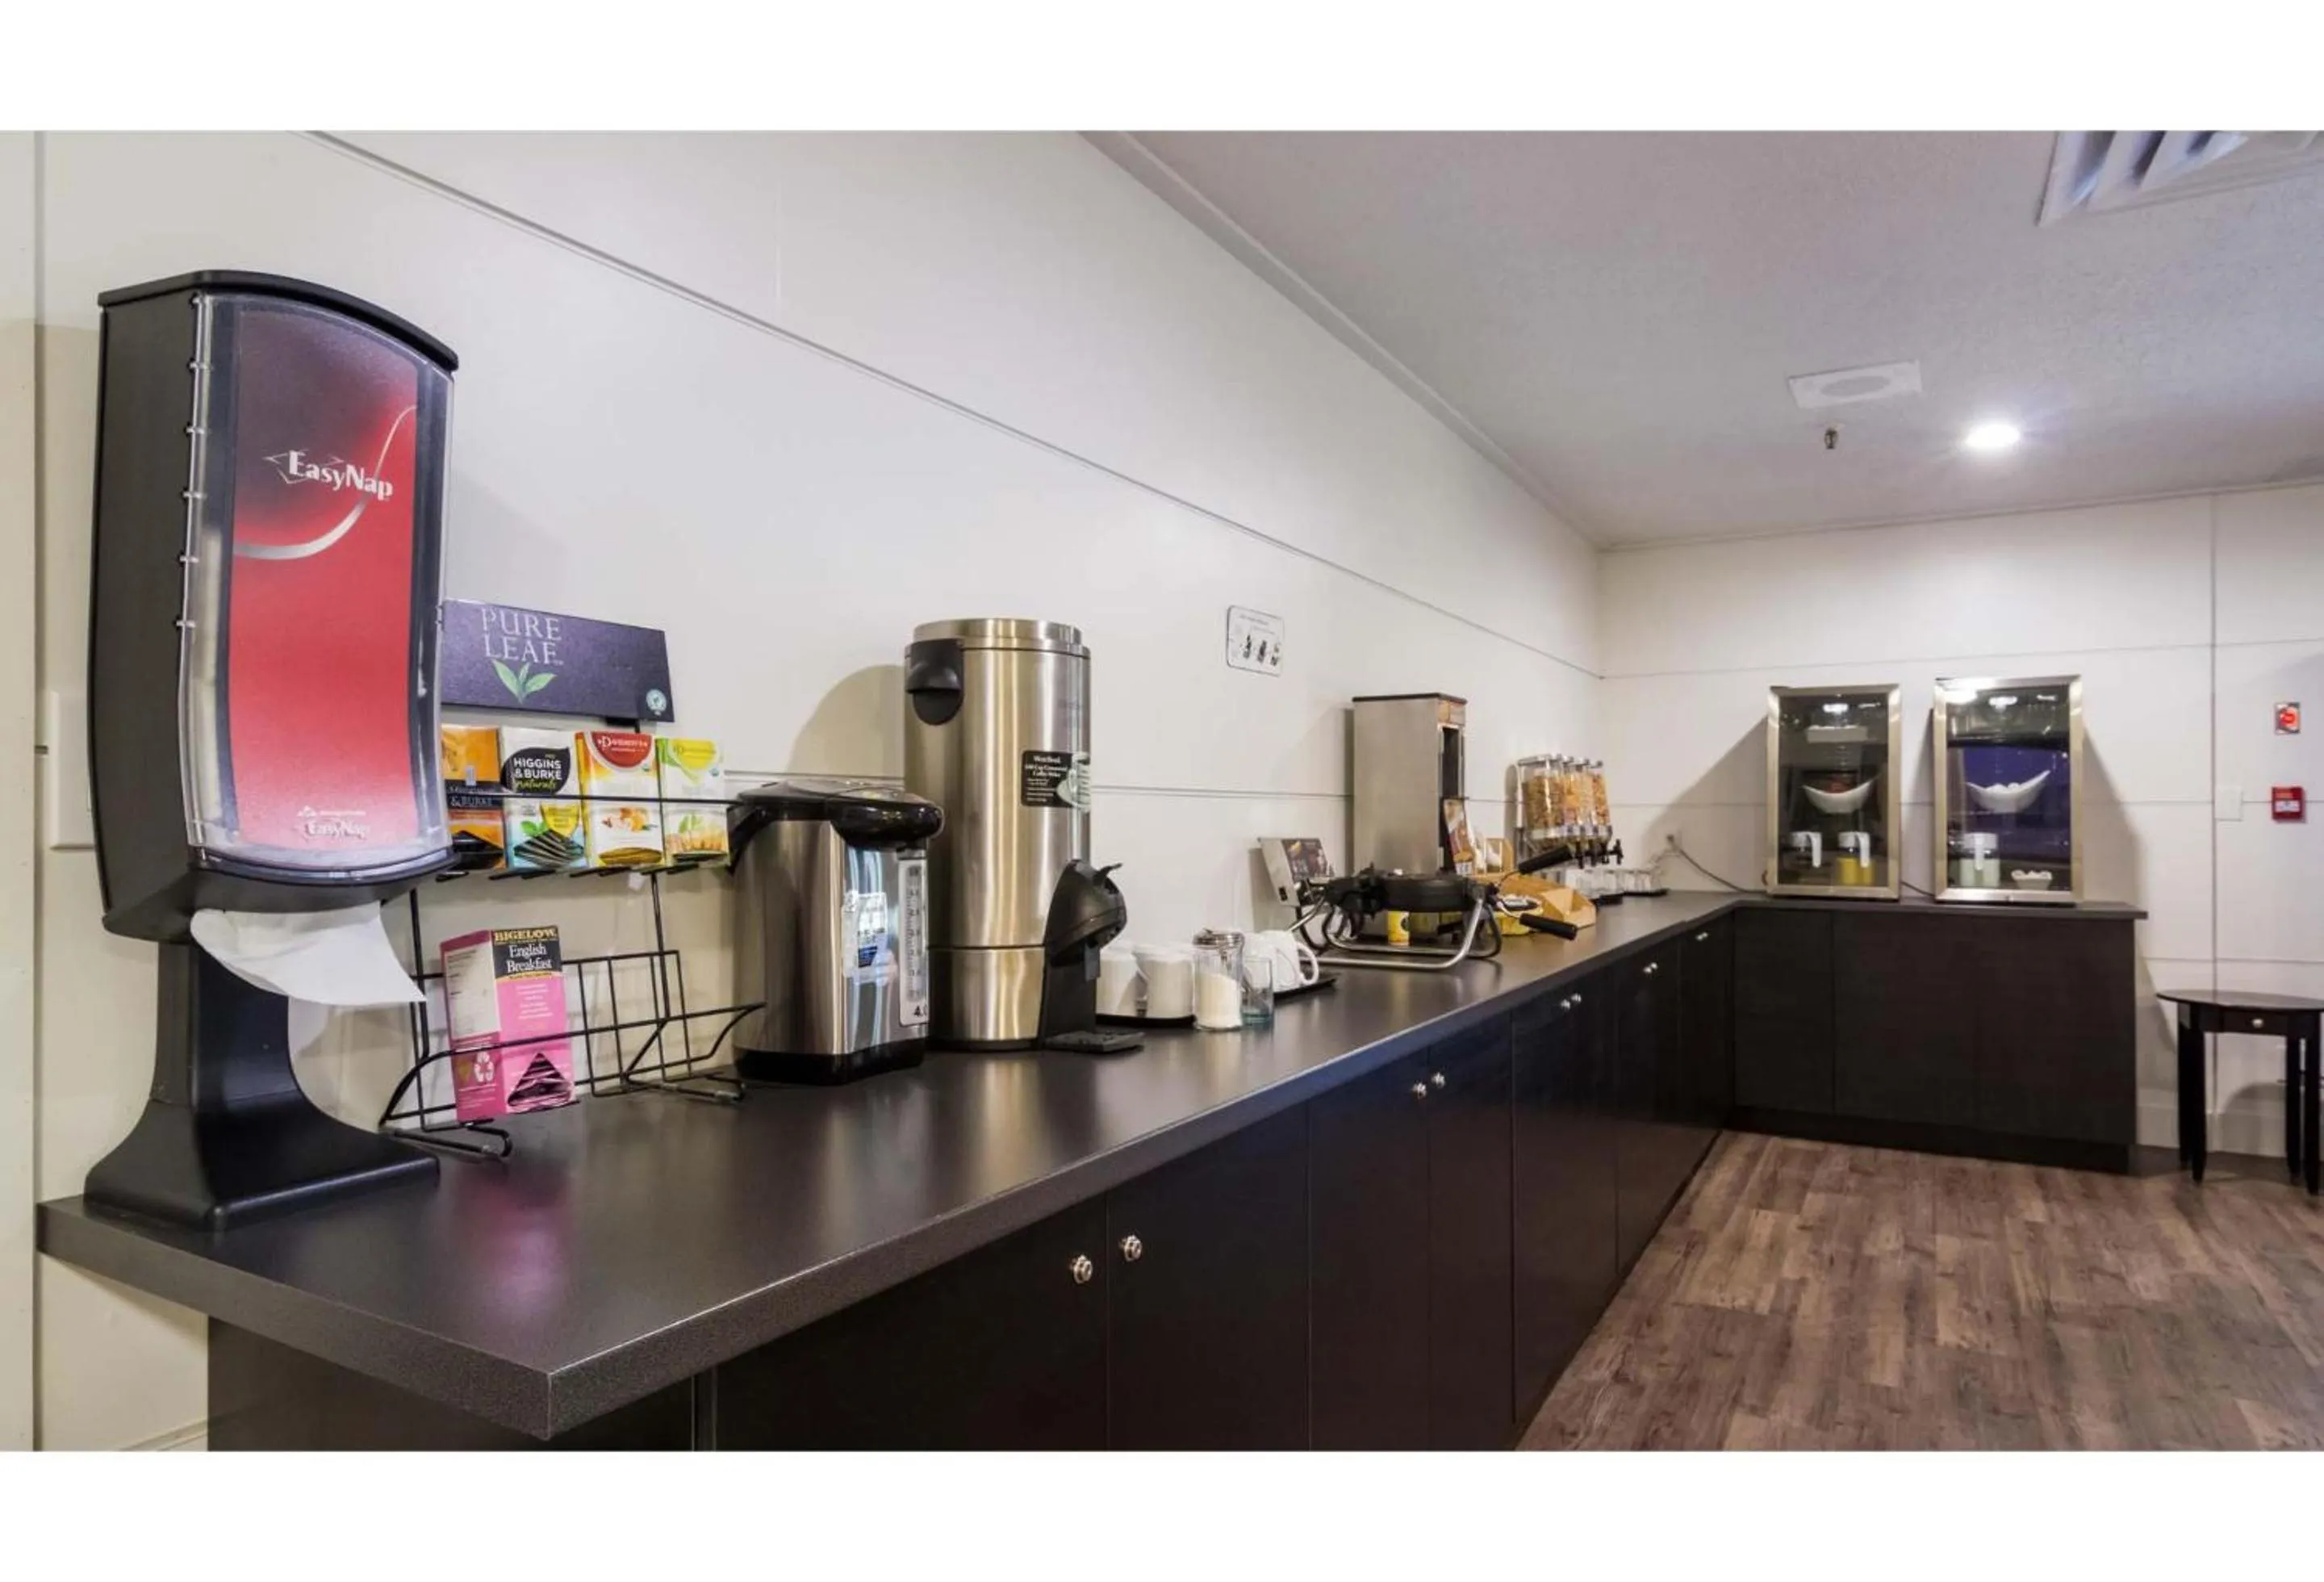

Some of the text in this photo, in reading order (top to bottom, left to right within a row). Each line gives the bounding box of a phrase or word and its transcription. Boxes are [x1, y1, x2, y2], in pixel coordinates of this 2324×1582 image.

[288, 450, 394, 501] EasyNap
[482, 607, 562, 641] PURE
[483, 634, 558, 664] LEAF
[513, 757, 562, 769] HIGGINS
[508, 942, 548, 959] English
[506, 957, 554, 973] Breakfast
